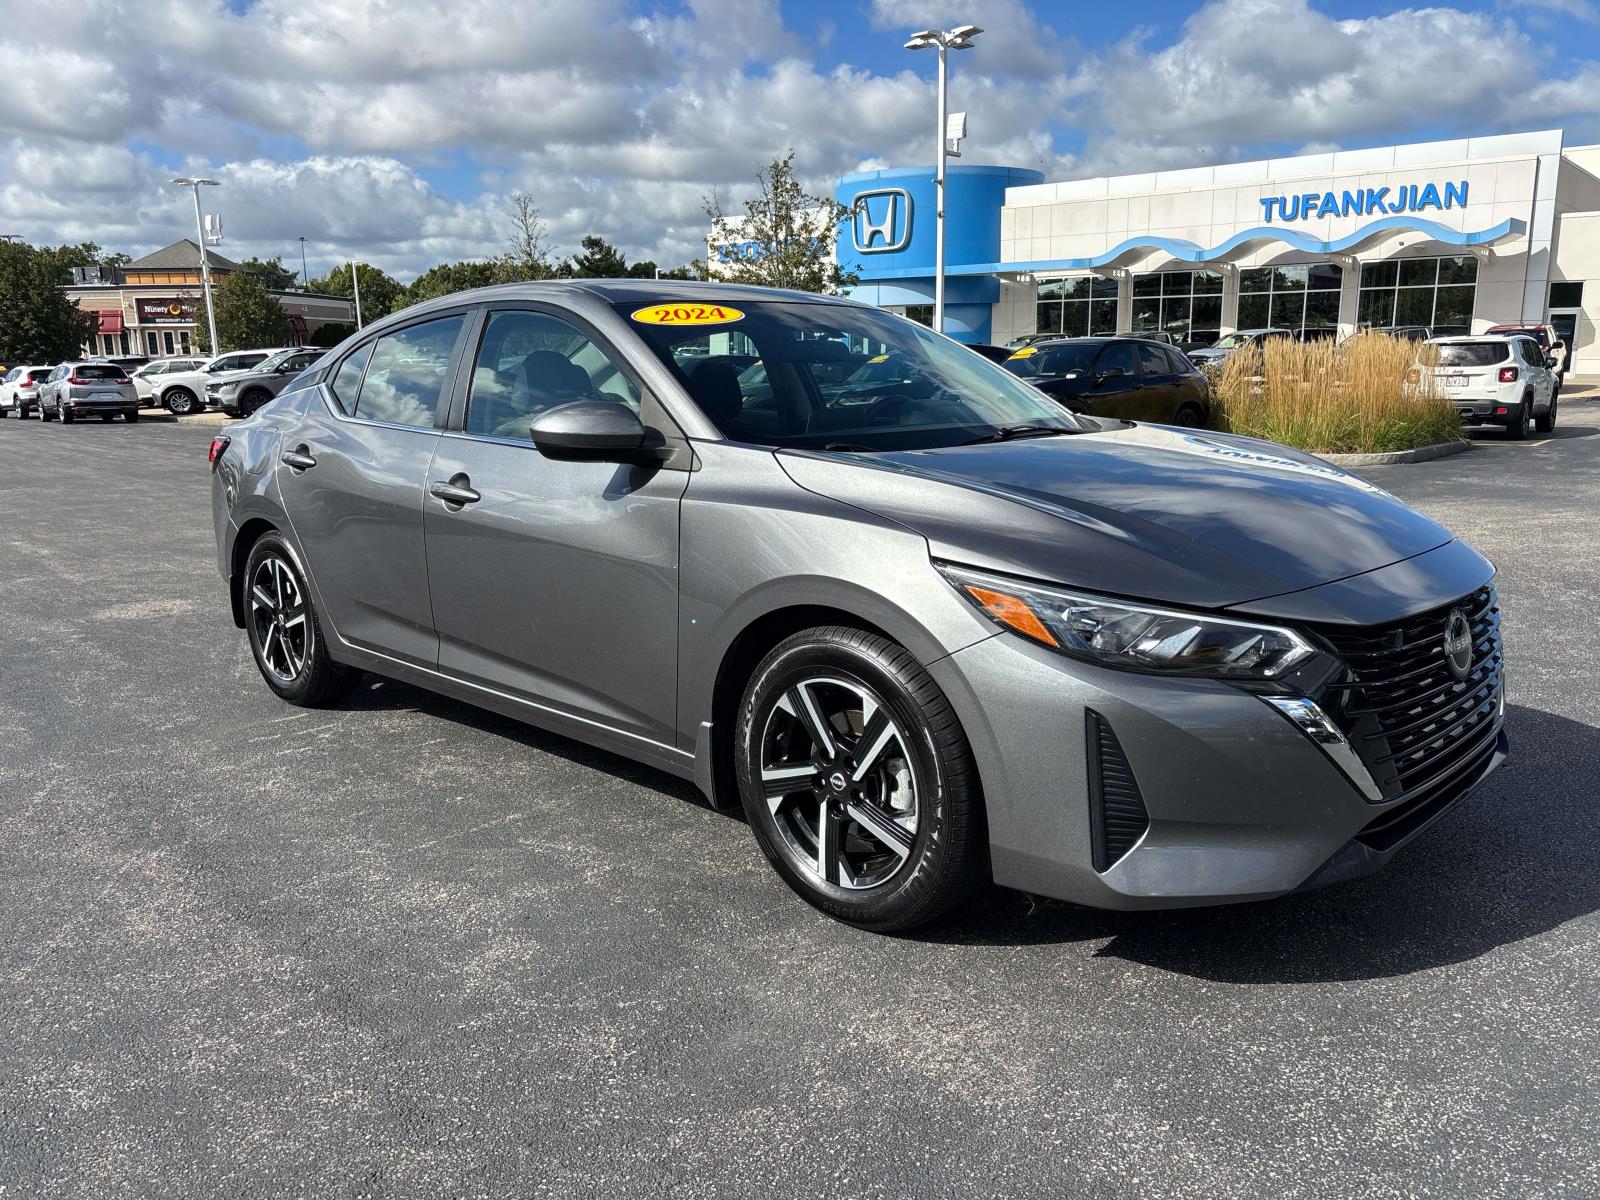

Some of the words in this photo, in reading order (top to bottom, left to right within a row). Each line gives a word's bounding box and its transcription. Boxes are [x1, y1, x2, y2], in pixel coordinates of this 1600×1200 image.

[1260, 181, 1469, 223] TUFANKJIAN
[144, 305, 168, 313] Ninety
[655, 307, 727, 322] 2024
